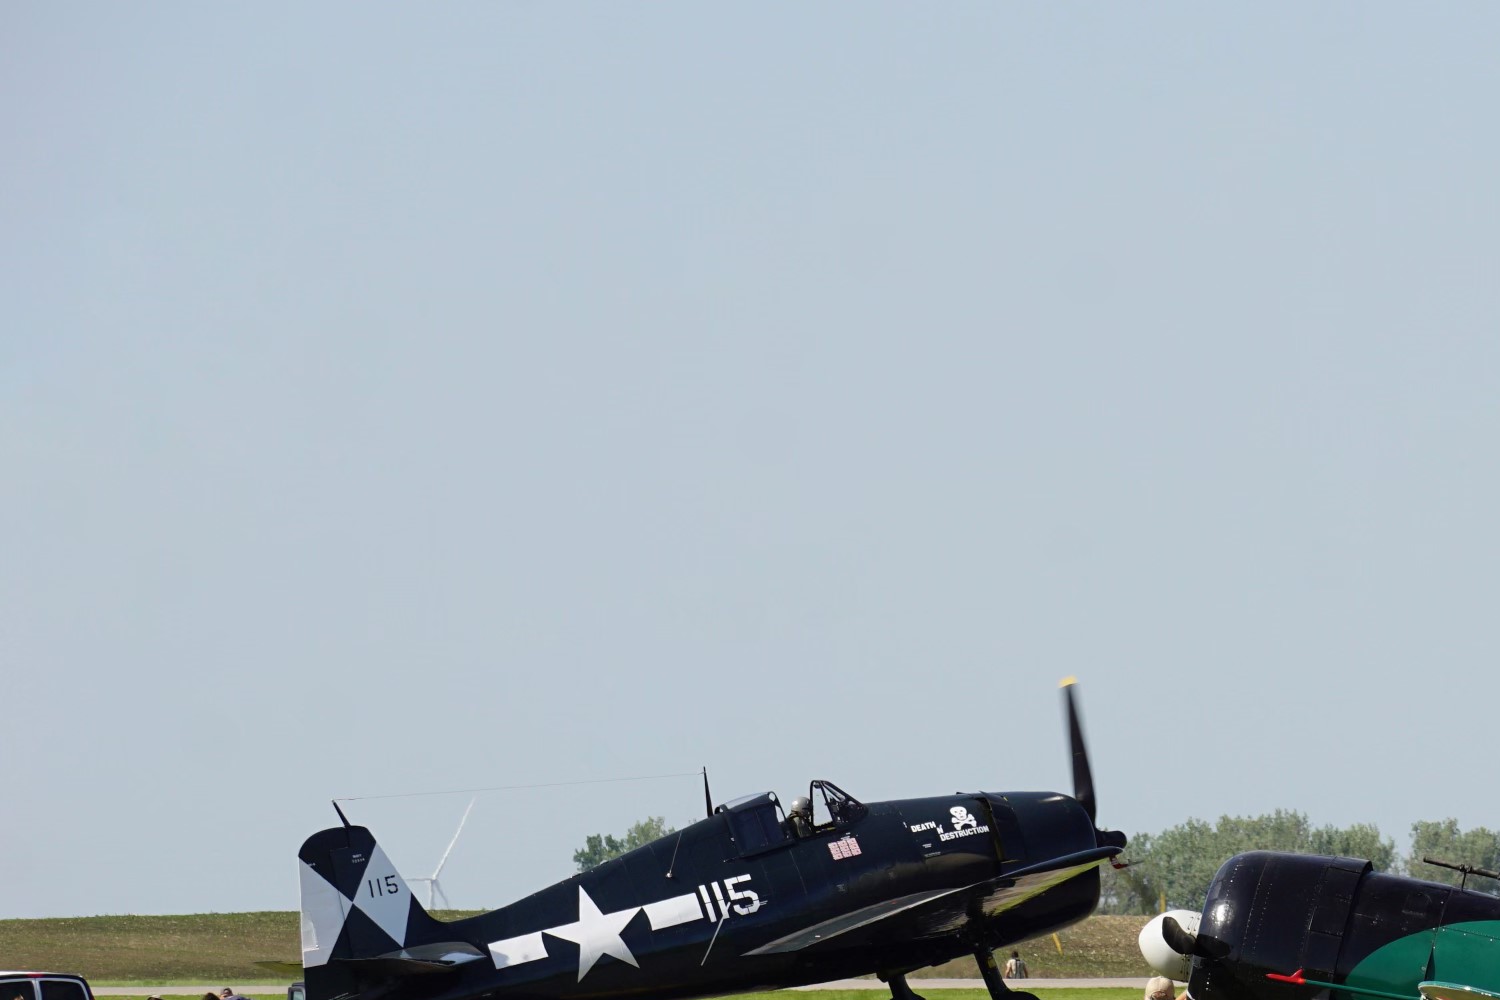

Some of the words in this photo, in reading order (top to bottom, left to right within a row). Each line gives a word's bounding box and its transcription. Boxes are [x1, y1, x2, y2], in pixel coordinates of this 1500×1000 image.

[910, 821, 937, 833] DEATH
[939, 825, 990, 842] DESTRUCTION
[368, 875, 399, 899] 115
[698, 873, 761, 923] 115
